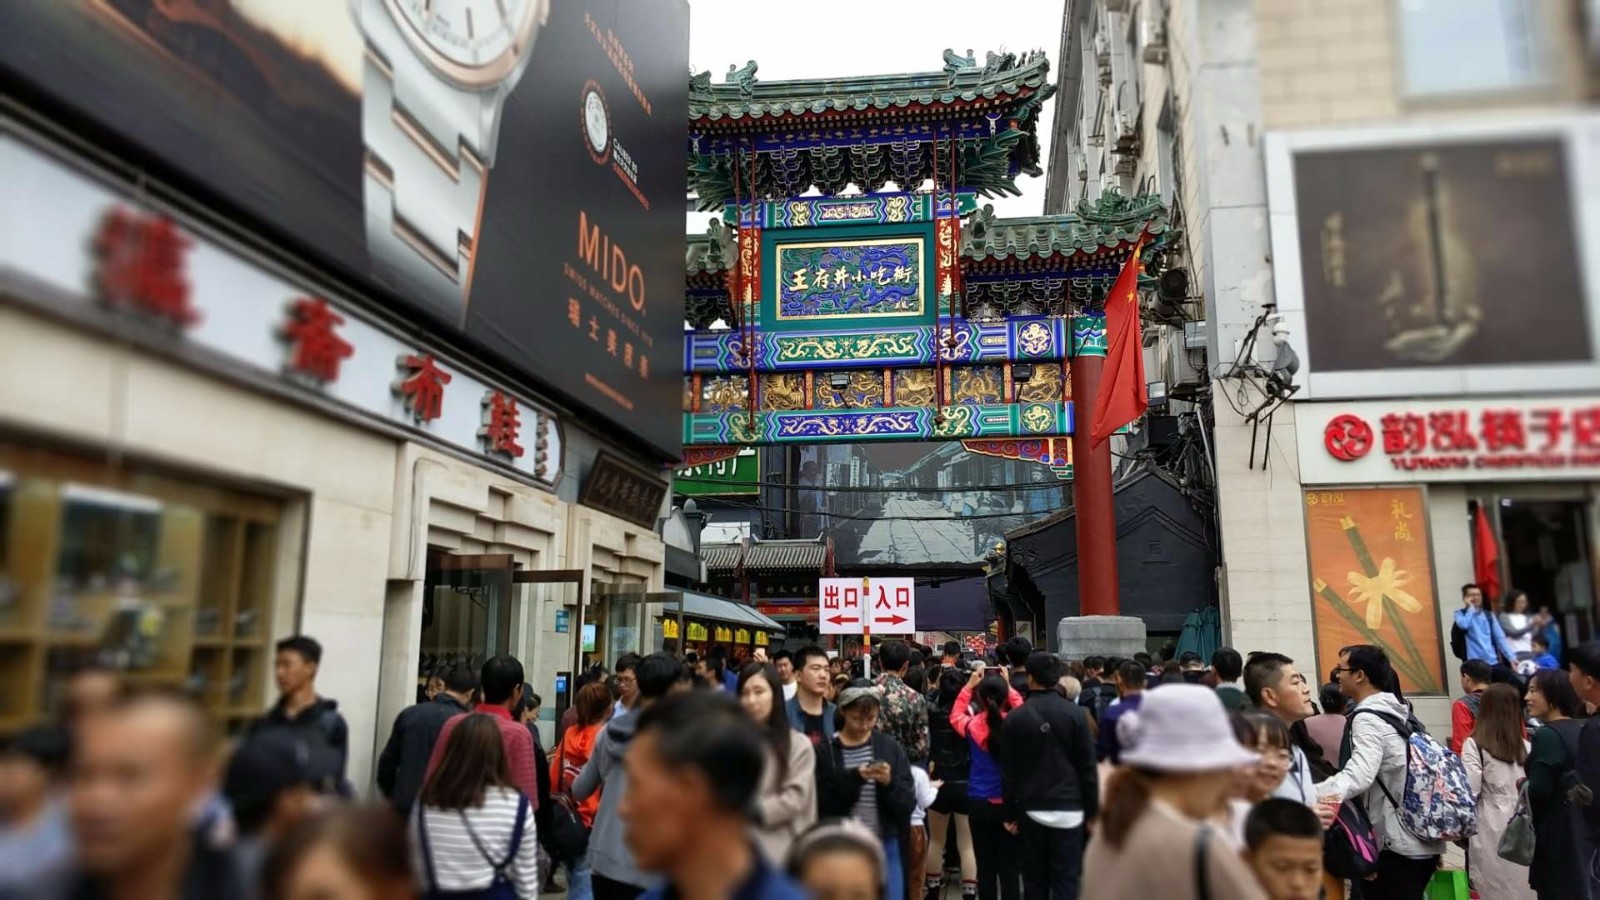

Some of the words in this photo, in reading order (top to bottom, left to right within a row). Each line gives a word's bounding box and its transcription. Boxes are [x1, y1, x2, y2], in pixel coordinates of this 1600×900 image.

[578, 211, 645, 310] MIDO
[788, 266, 913, 292] 王府井小吃街
[1391, 498, 1413, 541] 礼尚
[824, 585, 858, 610] 出口
[875, 585, 911, 610] 入口
